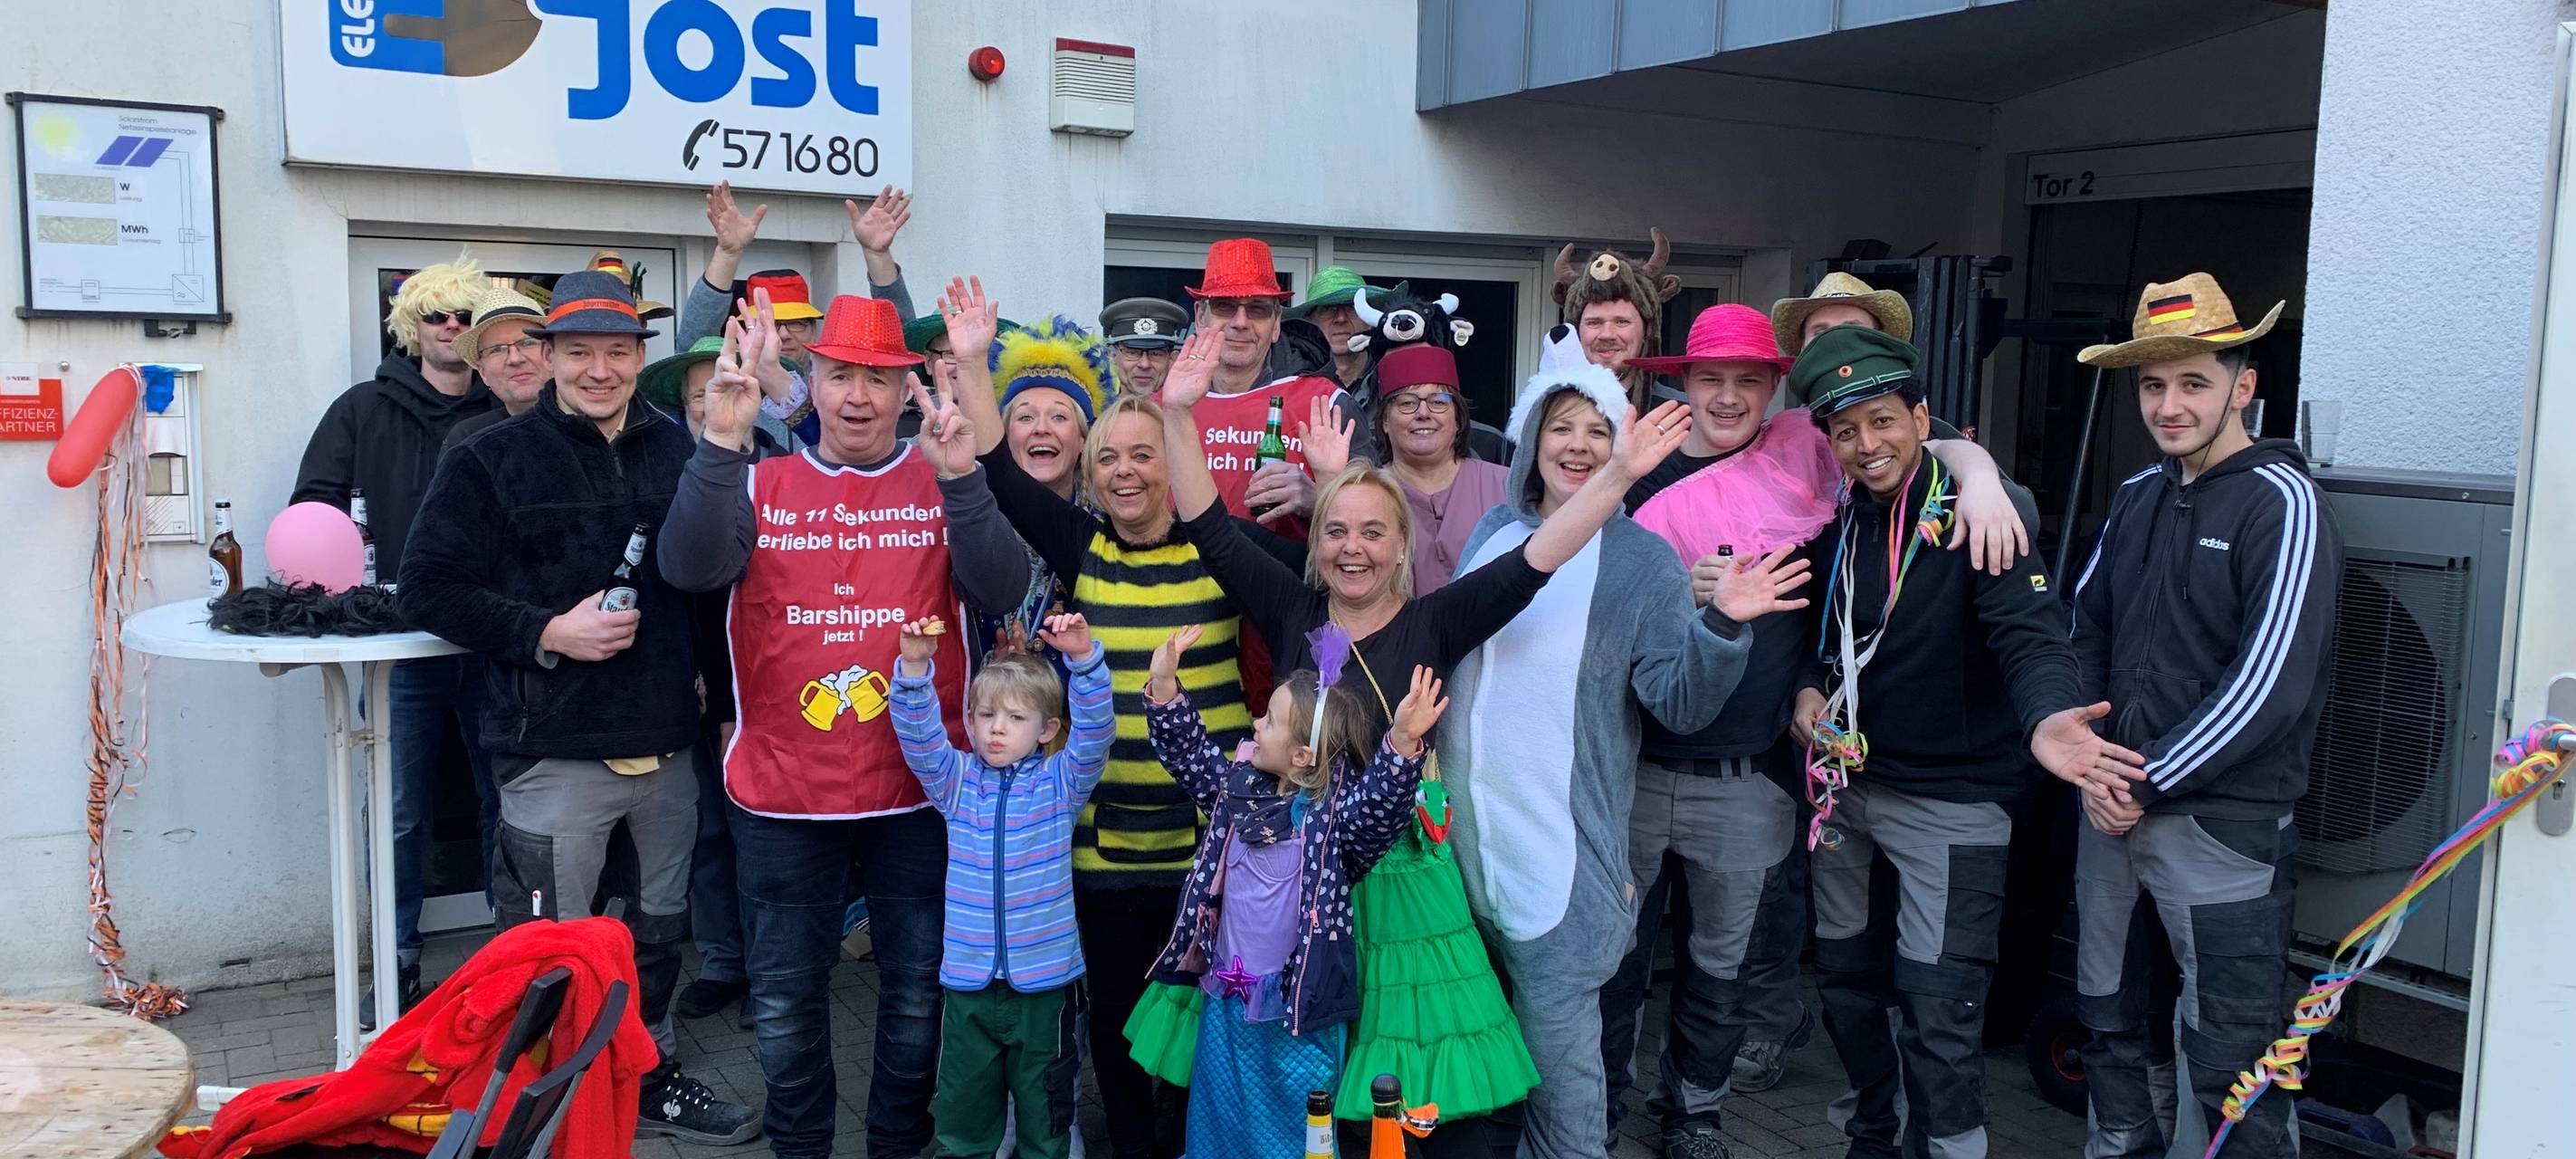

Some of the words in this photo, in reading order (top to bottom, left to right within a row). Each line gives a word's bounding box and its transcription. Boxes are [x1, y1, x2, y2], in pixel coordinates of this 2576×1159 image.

[119, 182, 130, 191] W
[2033, 173, 2073, 198] Tor
[2079, 170, 2094, 196] 2
[120, 224, 149, 235] MWh
[1205, 426, 1302, 452] Sekunen
[1207, 453, 1238, 471] ich
[761, 503, 797, 526] Alle
[805, 507, 828, 522] 11
[833, 503, 942, 526] Sekunden
[838, 532, 872, 551] ich
[878, 528, 936, 549] mich
[2199, 537, 2230, 551] adidas
[834, 582, 854, 596] Ich
[786, 605, 905, 627] Barshippe
[822, 629, 854, 646] jetzt
